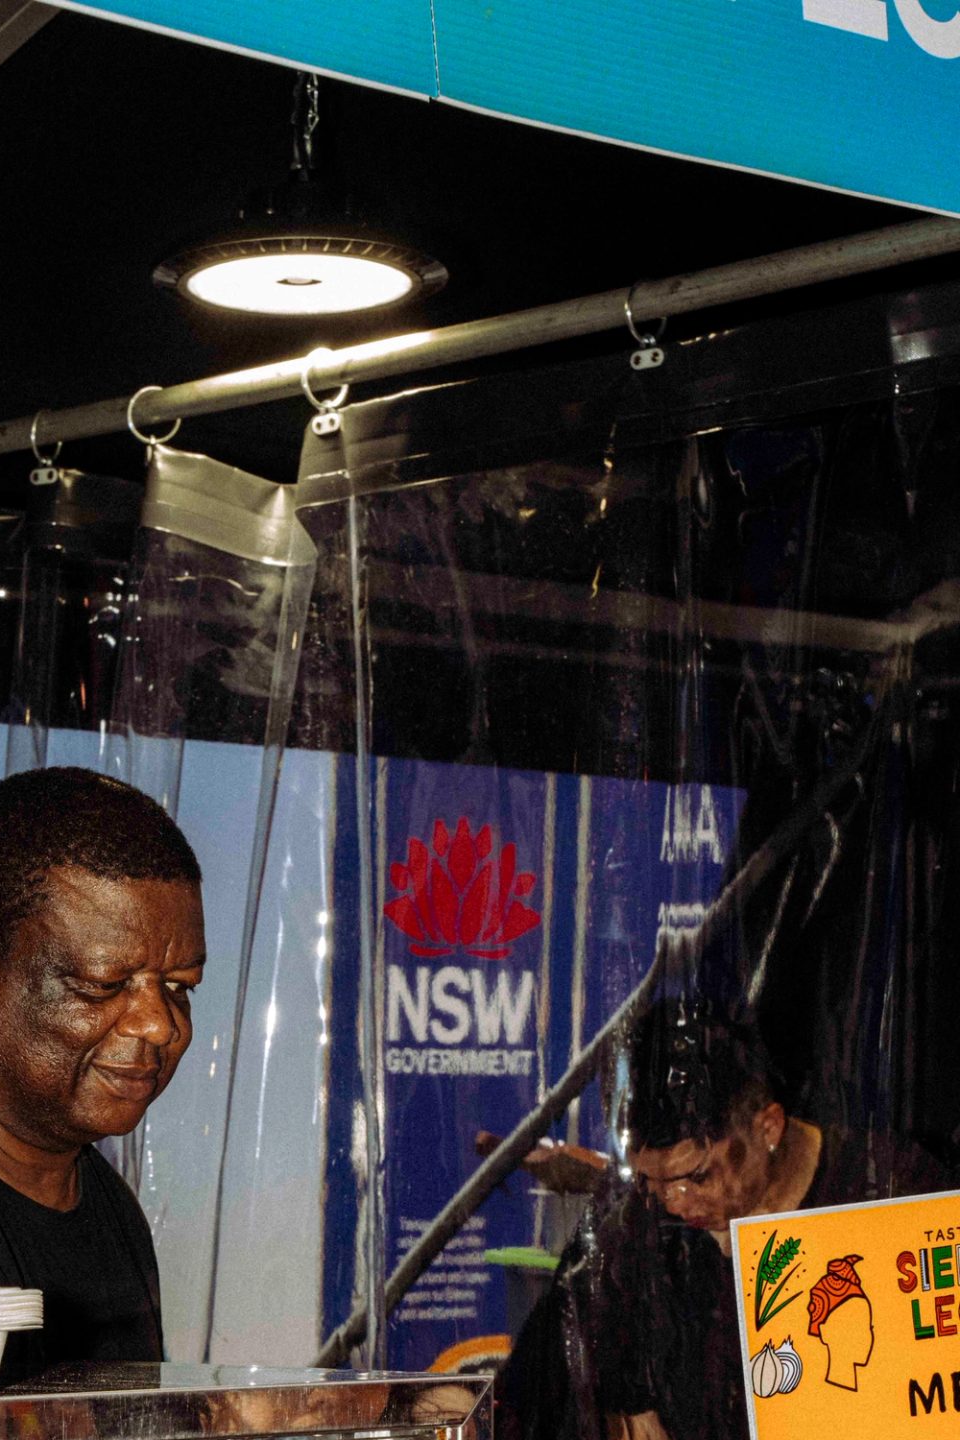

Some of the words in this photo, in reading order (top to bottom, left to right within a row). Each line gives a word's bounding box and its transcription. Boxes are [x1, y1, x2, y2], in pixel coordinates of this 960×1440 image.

[387, 964, 534, 1044] NSW
[386, 1047, 534, 1076] GOVERNMENT
[896, 1244, 960, 1293] SIE
[911, 1294, 960, 1340] LE
